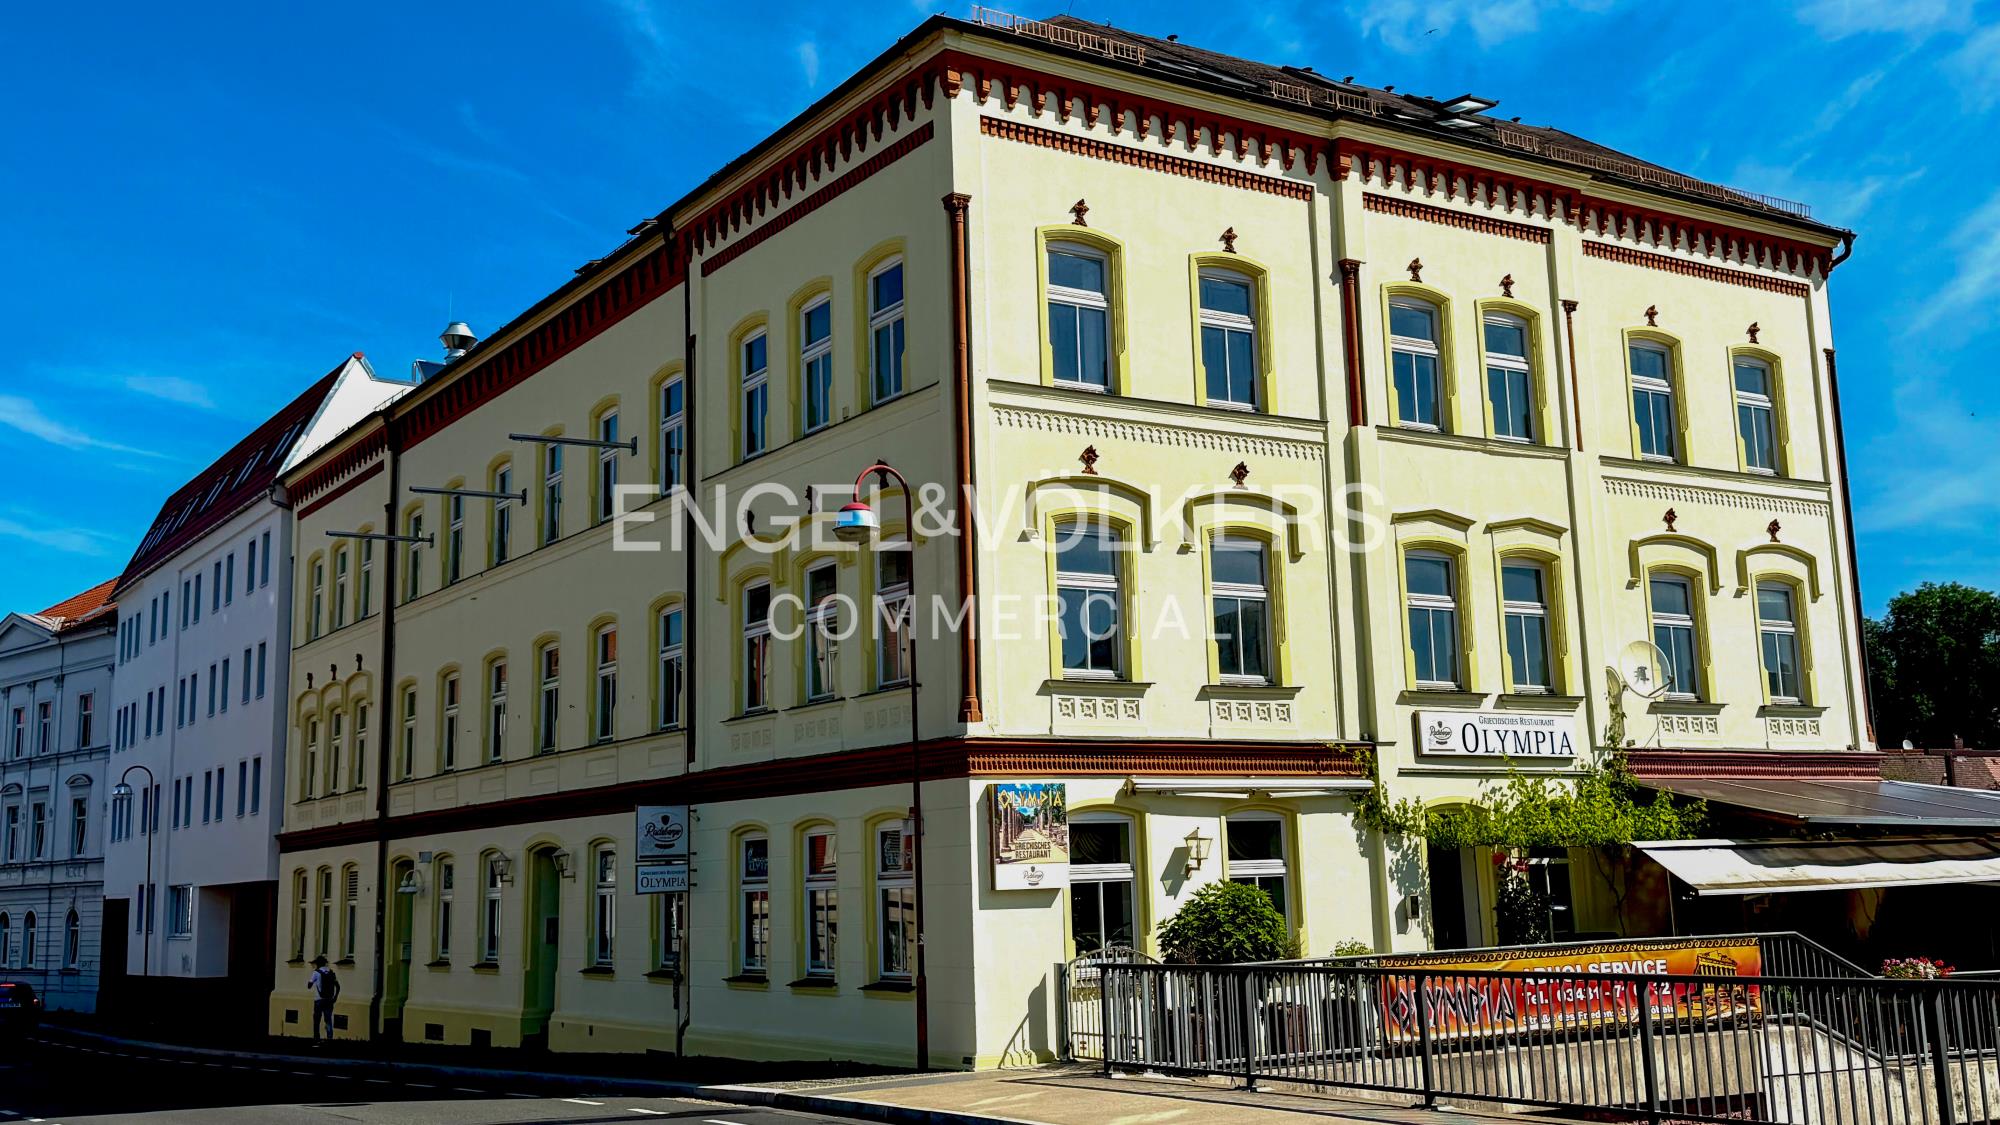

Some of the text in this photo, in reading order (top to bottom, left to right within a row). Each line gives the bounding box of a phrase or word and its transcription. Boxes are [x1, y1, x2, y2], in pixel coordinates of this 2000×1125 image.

[1519, 717, 1555, 727] RESTAURANT
[1461, 722, 1574, 755] OLYMPIA
[998, 789, 1062, 808] OLYMPIA
[1015, 841, 1051, 850] GRIECHISCHES
[1015, 850, 1051, 859] RESTAURANT
[640, 876, 686, 888] OLYMPIA
[1522, 1013, 1555, 1025] Strß
